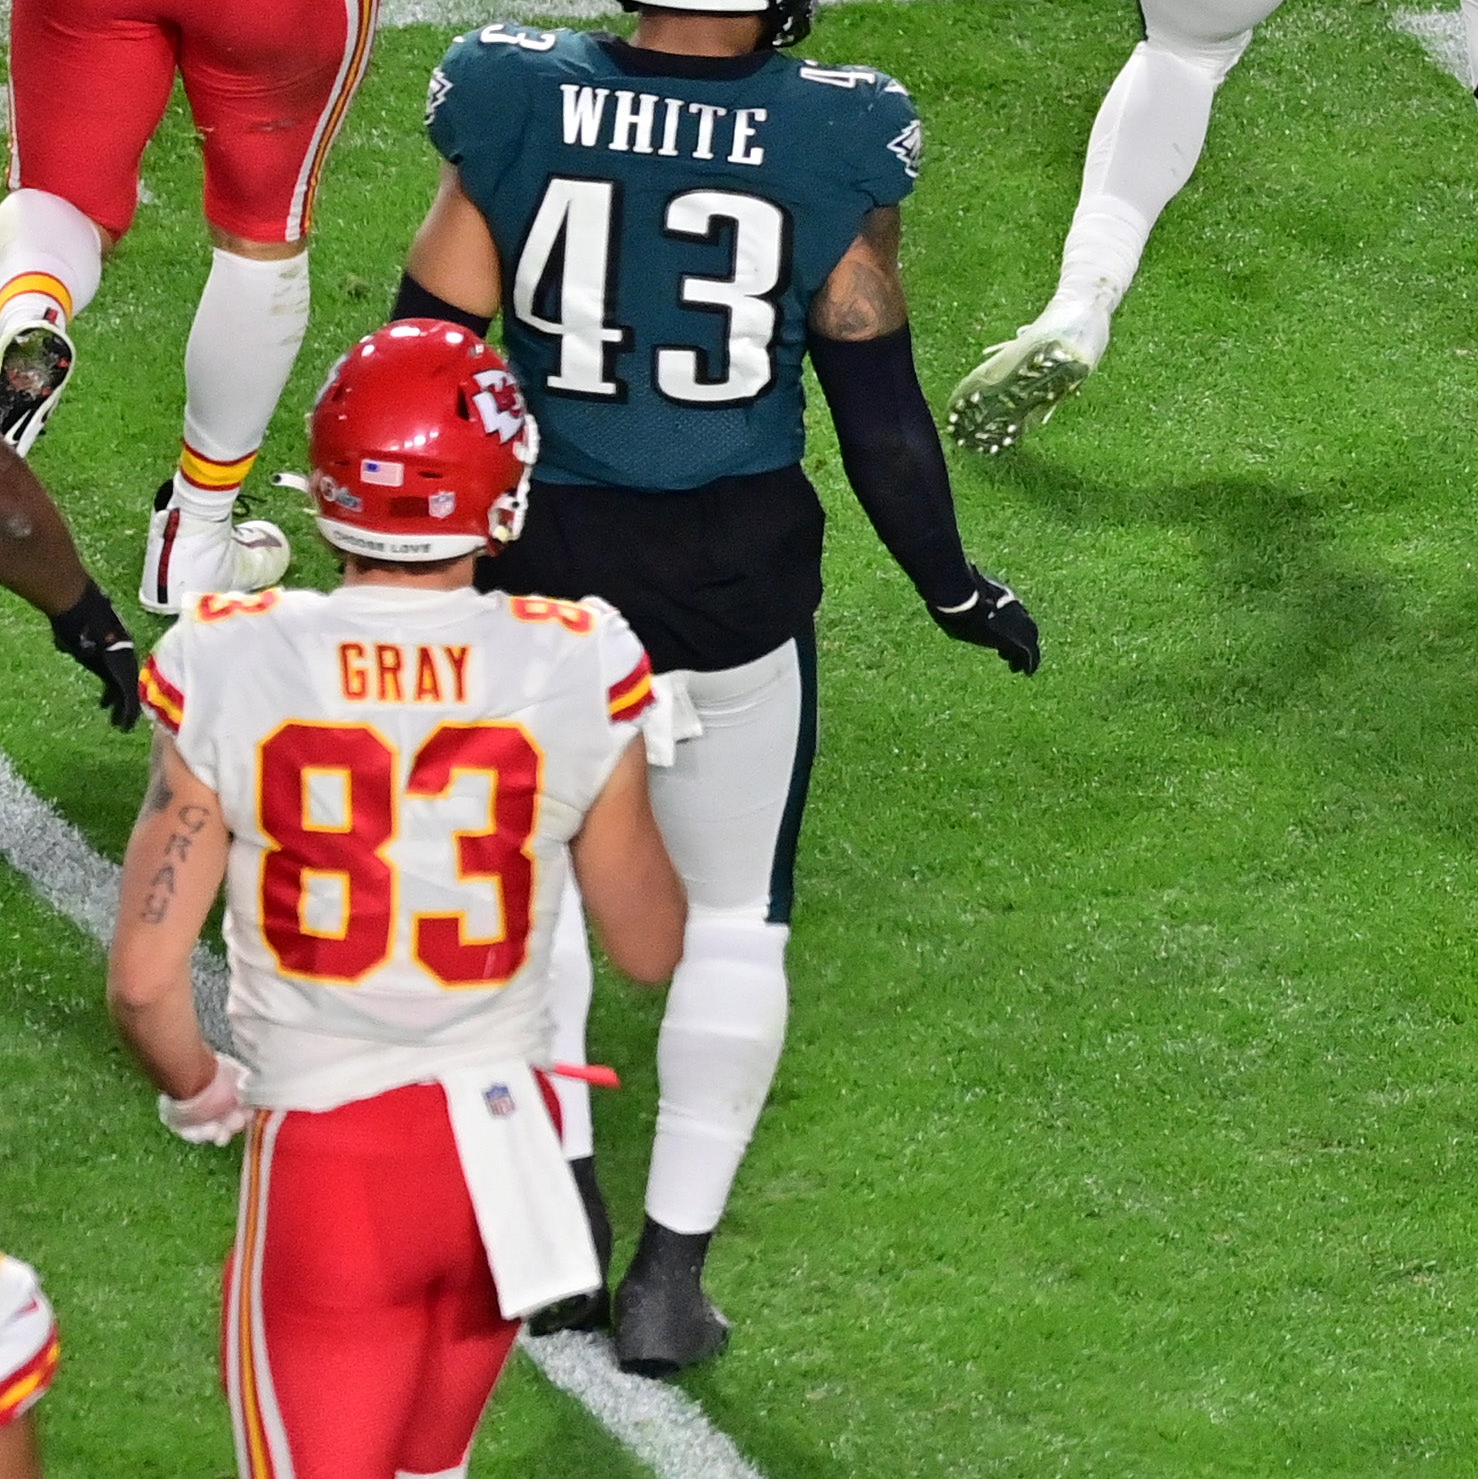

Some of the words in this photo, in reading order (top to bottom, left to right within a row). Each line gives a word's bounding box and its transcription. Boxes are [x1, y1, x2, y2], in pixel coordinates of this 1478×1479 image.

[559, 83, 768, 166] WHITE
[511, 177, 784, 403] 43
[336, 640, 473, 704] GRAY
[255, 717, 544, 993] 83
